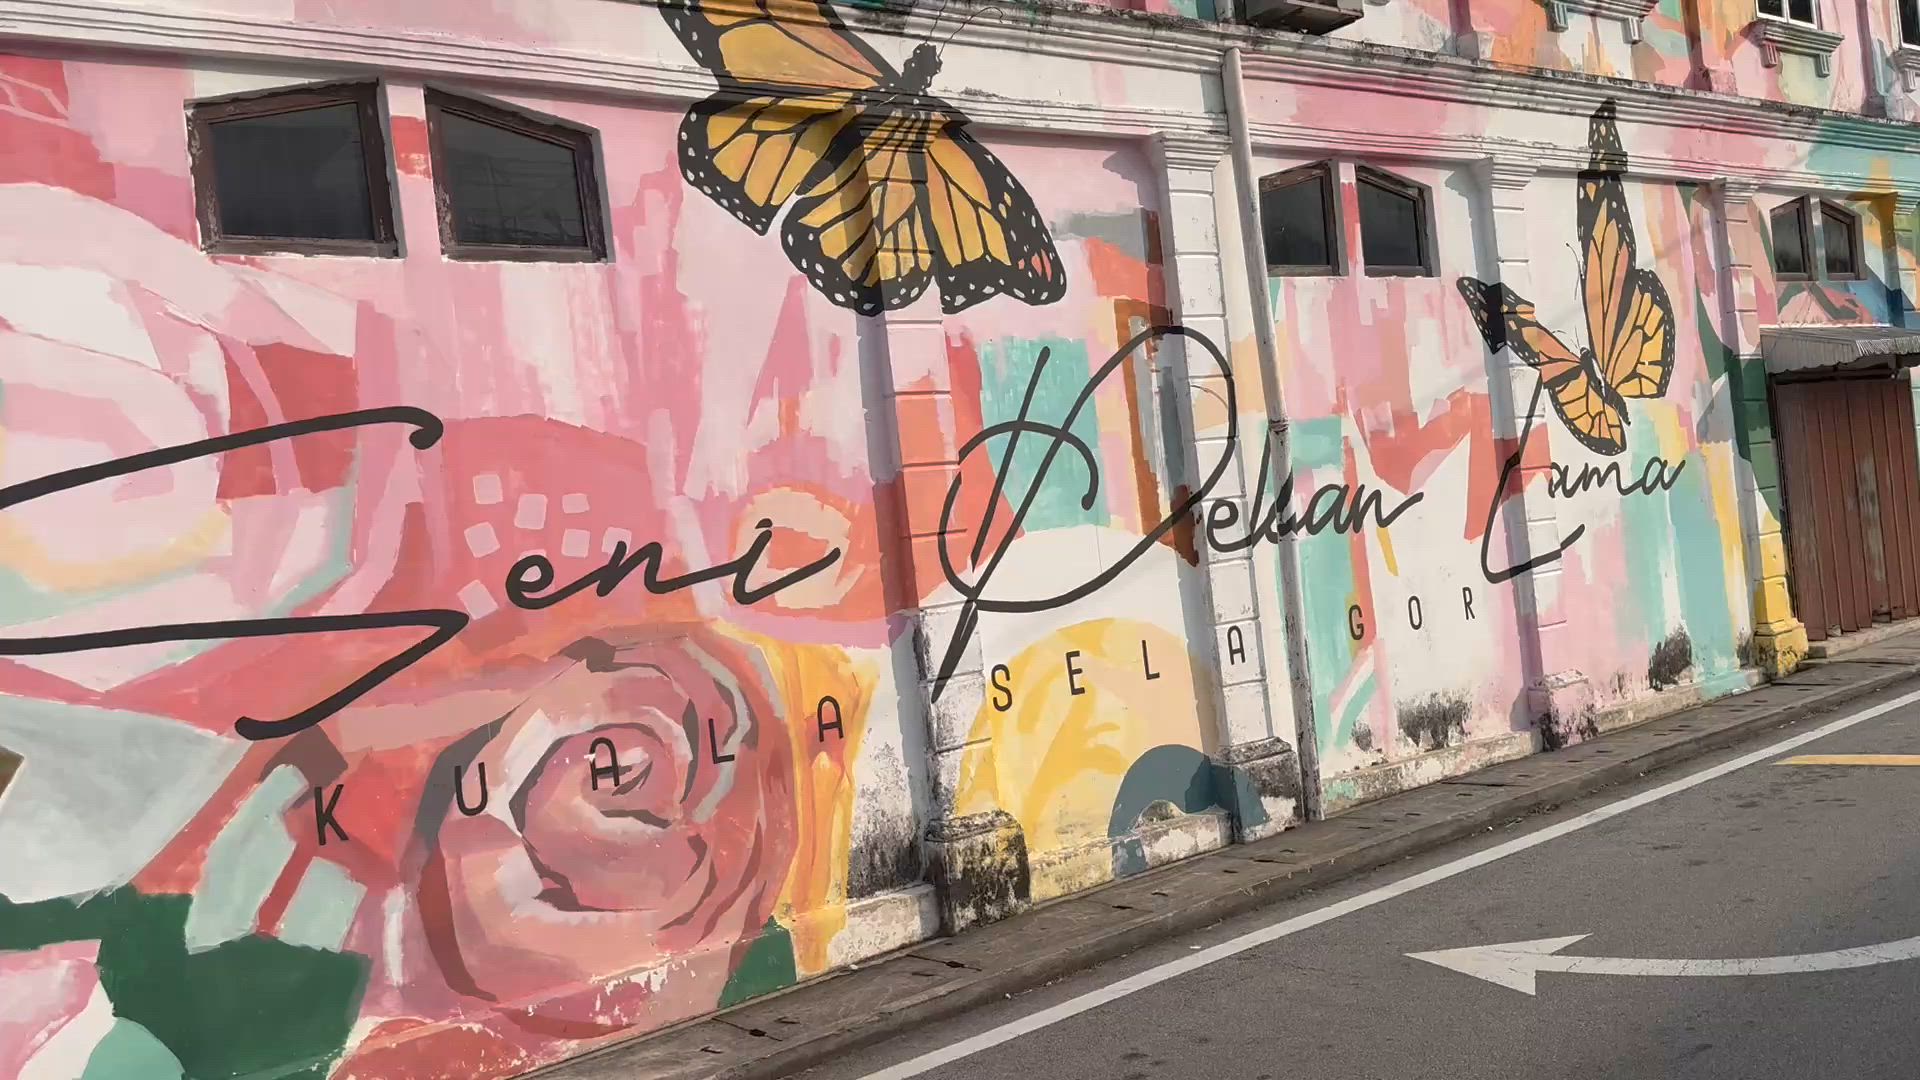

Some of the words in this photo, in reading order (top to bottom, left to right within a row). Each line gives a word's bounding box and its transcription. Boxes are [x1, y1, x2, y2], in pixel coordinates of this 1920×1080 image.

[931, 324, 1422, 702] Pekan
[1481, 372, 1686, 584] Lama
[314, 696, 844, 846] KUALA
[991, 585, 1477, 712] SELAGOR
